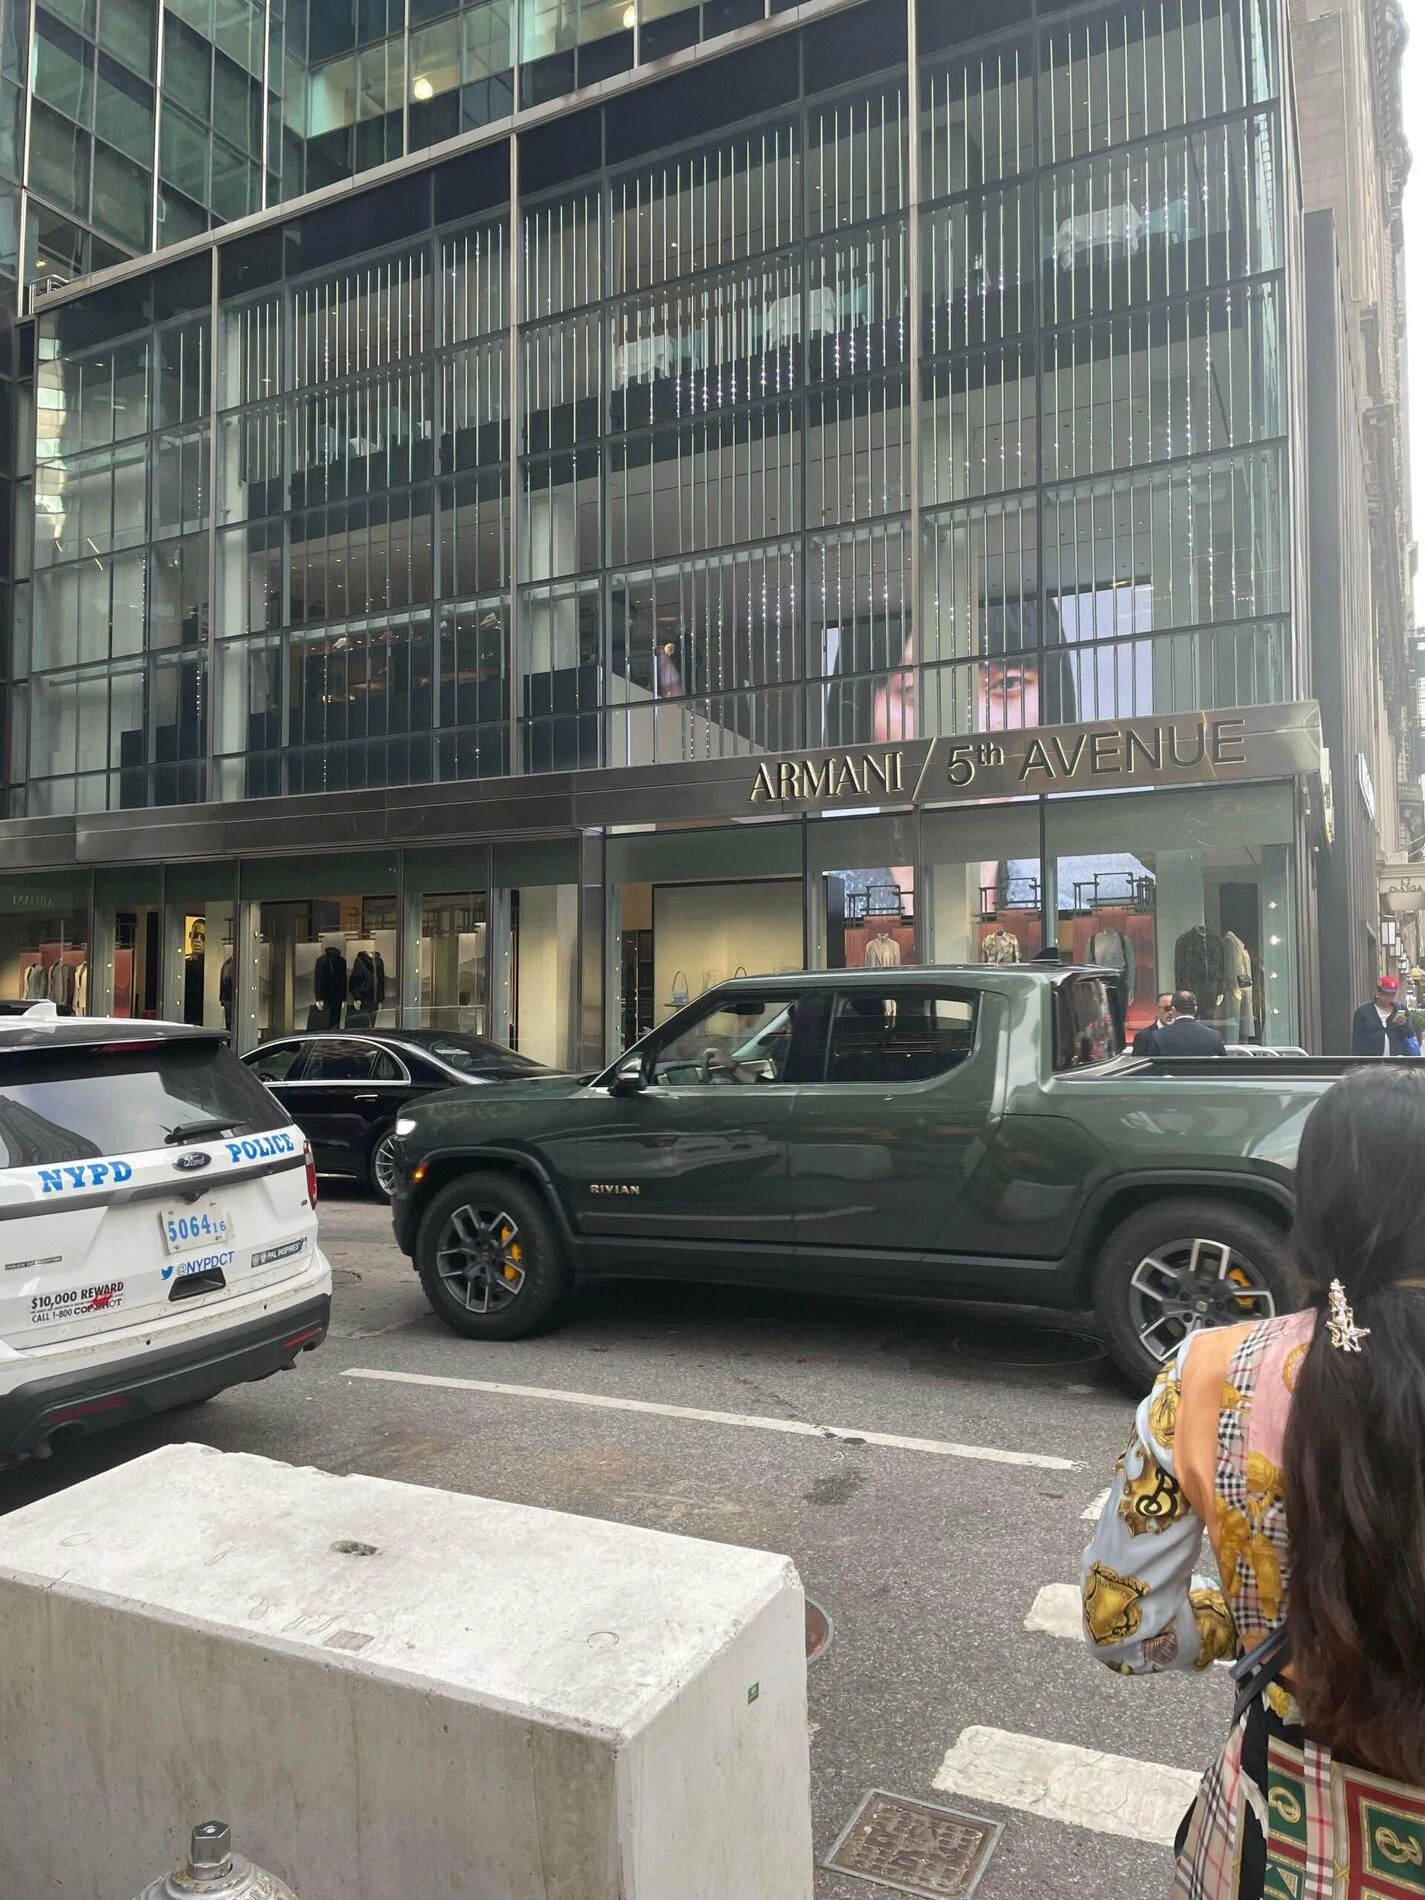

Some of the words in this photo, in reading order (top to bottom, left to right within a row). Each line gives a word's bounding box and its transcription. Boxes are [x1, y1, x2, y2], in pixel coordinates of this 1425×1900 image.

[748, 751, 904, 802] ARMANI
[946, 741, 1004, 787] 5th
[1018, 718, 1246, 781] AVENUE
[225, 1133, 295, 1164] POLICE
[37, 1160, 133, 1193] NYPD
[590, 1184, 641, 1195] RIVIAN
[167, 1213, 211, 1242] 5064
[212, 1221, 227, 1233] 16
[176, 1251, 235, 1276] @NYPDCT
[31, 1291, 77, 1310] $10,000
[80, 1281, 124, 1300] REWARD
[31, 1312, 50, 1323] CALL
